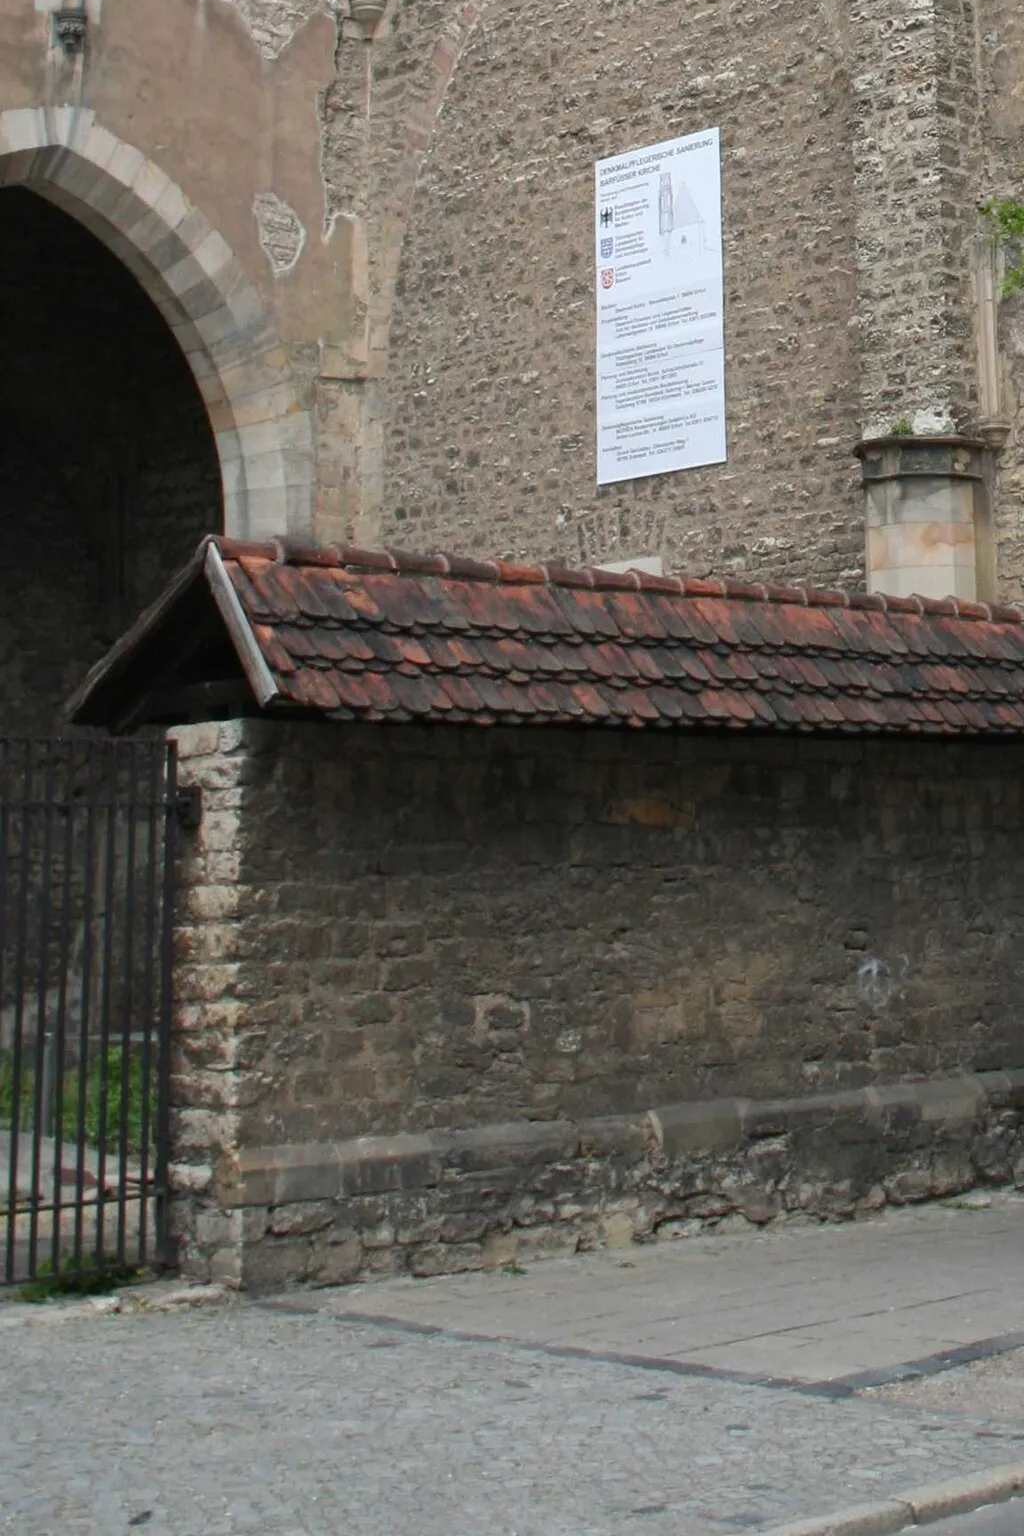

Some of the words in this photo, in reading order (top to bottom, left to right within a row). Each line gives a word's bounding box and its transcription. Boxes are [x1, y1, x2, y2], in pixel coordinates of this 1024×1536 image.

[600, 149, 674, 176] DENKMALPFLEGERISCHE
[676, 138, 713, 155] SANIERUNG
[638, 164, 660, 176] KIRCHE
